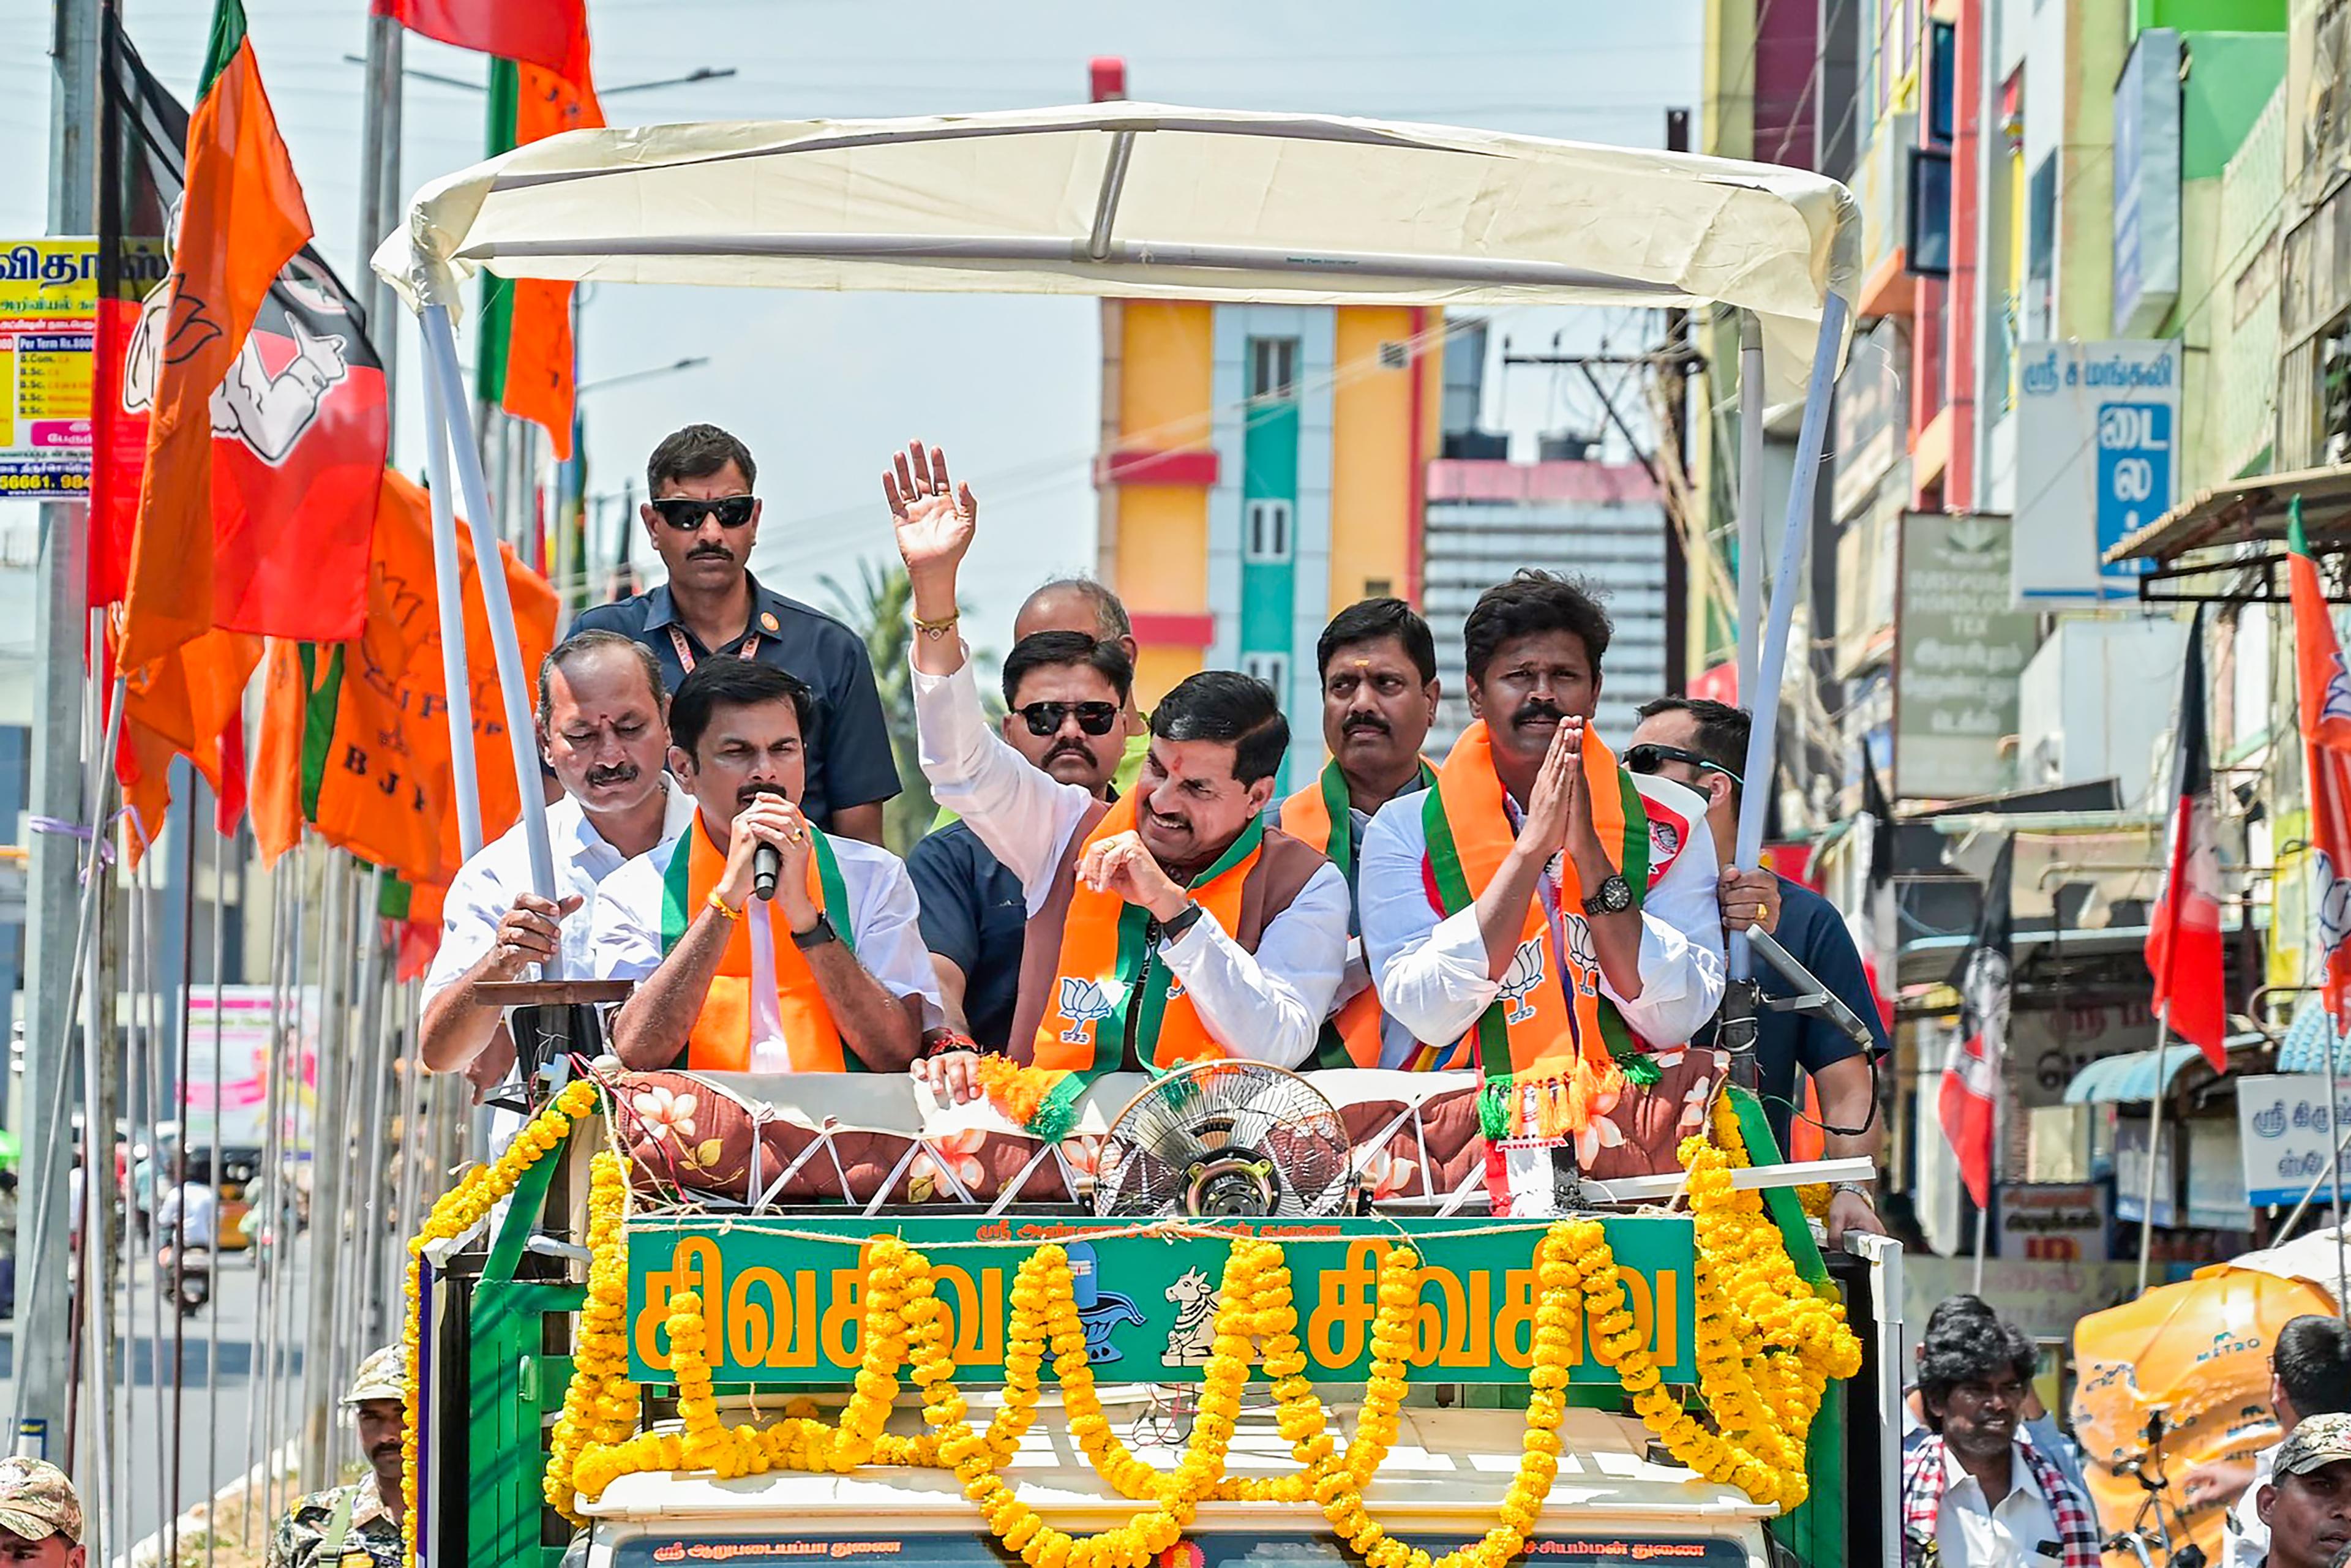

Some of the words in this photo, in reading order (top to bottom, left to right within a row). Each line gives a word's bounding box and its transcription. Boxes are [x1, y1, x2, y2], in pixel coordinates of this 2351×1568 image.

[20, 338, 35, 349] Per
[37, 338, 58, 349] Term
[653, 1542, 686, 1561] ஸ்ரீ
